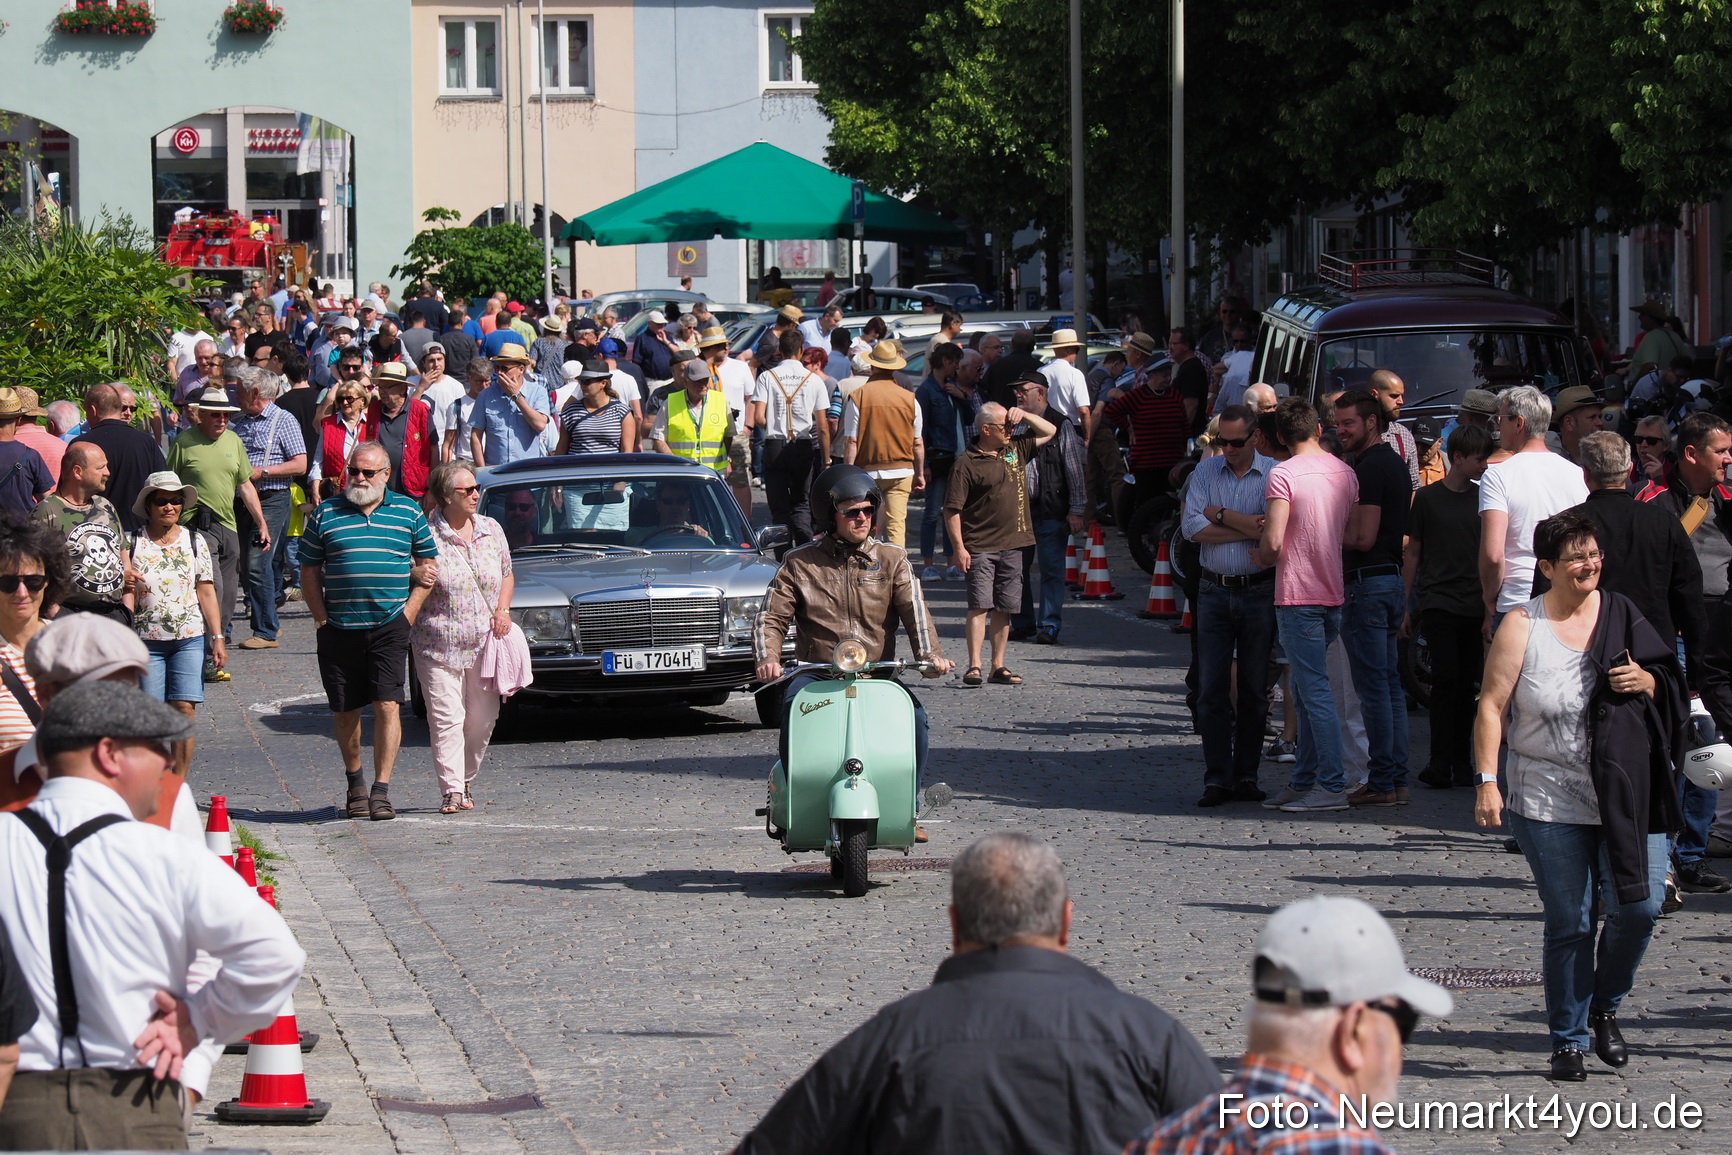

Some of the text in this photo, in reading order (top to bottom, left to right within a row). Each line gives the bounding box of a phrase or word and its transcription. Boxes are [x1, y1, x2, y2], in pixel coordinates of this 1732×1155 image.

[180, 138, 193, 147] KH
[854, 187, 862, 216] P
[96, 582, 114, 593] Suhl
[644, 650, 691, 669] T704H
[799, 698, 835, 718] Vespa
